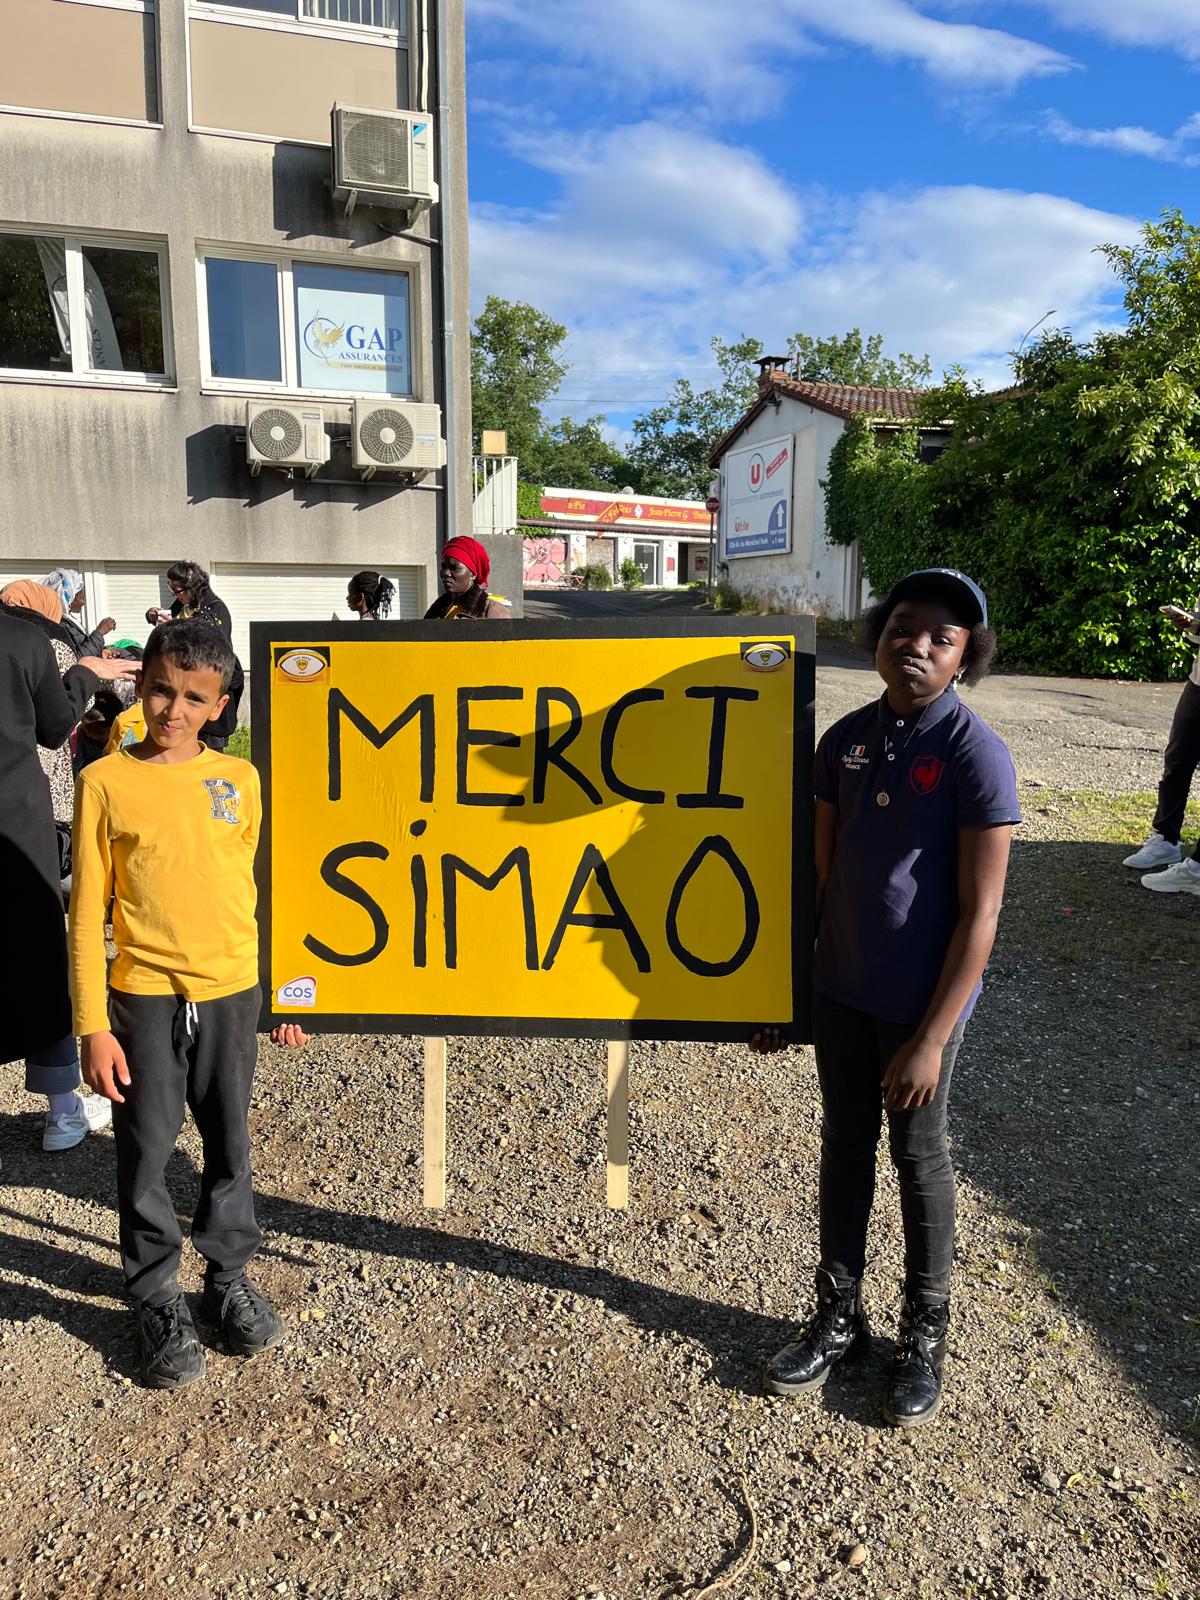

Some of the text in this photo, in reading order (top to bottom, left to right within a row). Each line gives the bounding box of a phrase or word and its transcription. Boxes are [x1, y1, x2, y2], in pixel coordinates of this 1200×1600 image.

[345, 325, 402, 351] GAP
[338, 351, 403, 363] ASSURANCES
[751, 463, 761, 485] U
[328, 685, 760, 809] MERCI
[283, 986, 312, 998] COS
